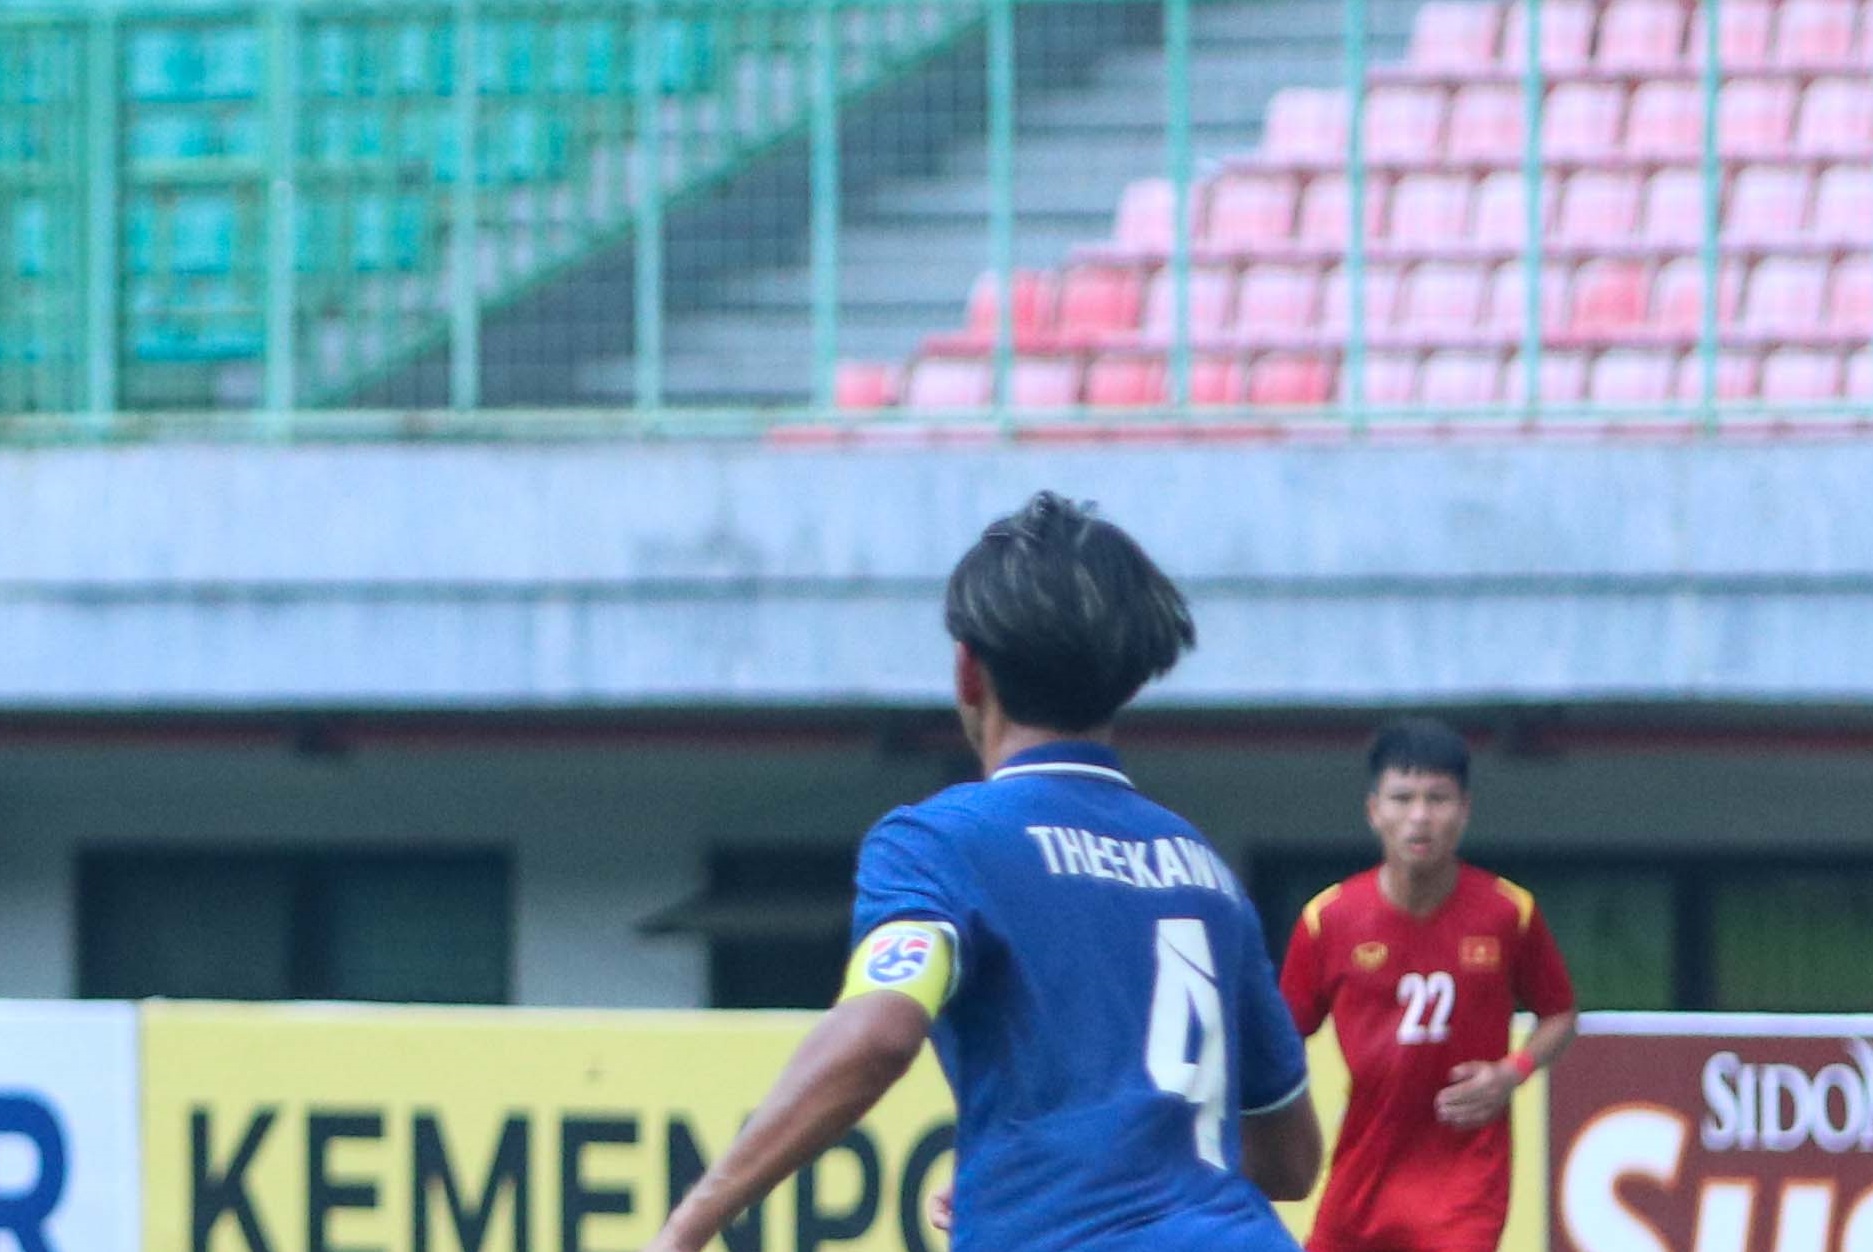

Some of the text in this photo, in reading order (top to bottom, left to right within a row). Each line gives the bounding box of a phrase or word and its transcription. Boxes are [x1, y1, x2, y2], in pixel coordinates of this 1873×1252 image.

[1145, 918, 1229, 1171] 4
[1395, 970, 1457, 1046] 22
[1701, 1038, 1873, 1151] SIDO
